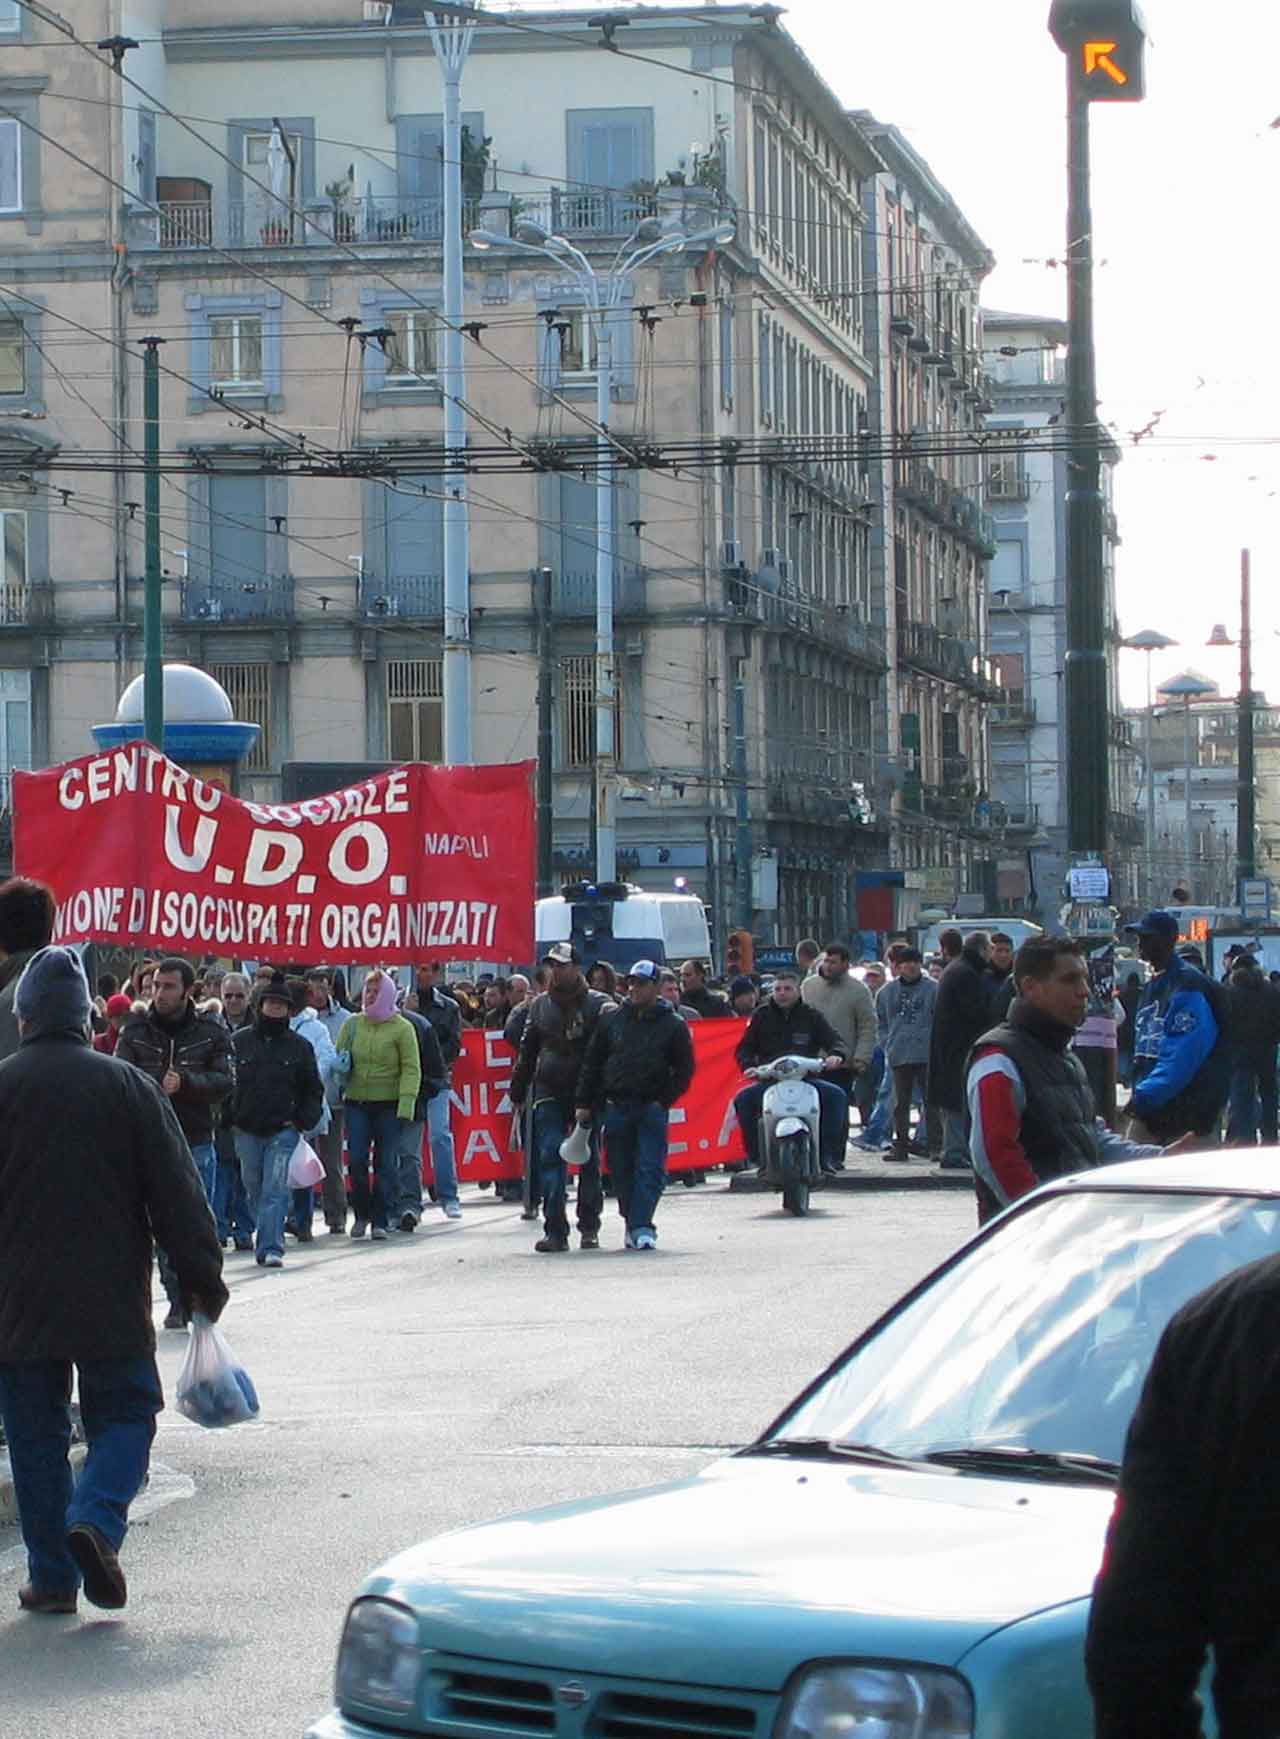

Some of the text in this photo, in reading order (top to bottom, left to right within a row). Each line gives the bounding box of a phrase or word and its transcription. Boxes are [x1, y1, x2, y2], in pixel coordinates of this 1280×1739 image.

[59, 746, 408, 828] CENTRO SOCIALE
[164, 804, 408, 895] U.D.O.
[51, 887, 124, 943] NIONE
[321, 903, 498, 949] ORGANIZZATI
